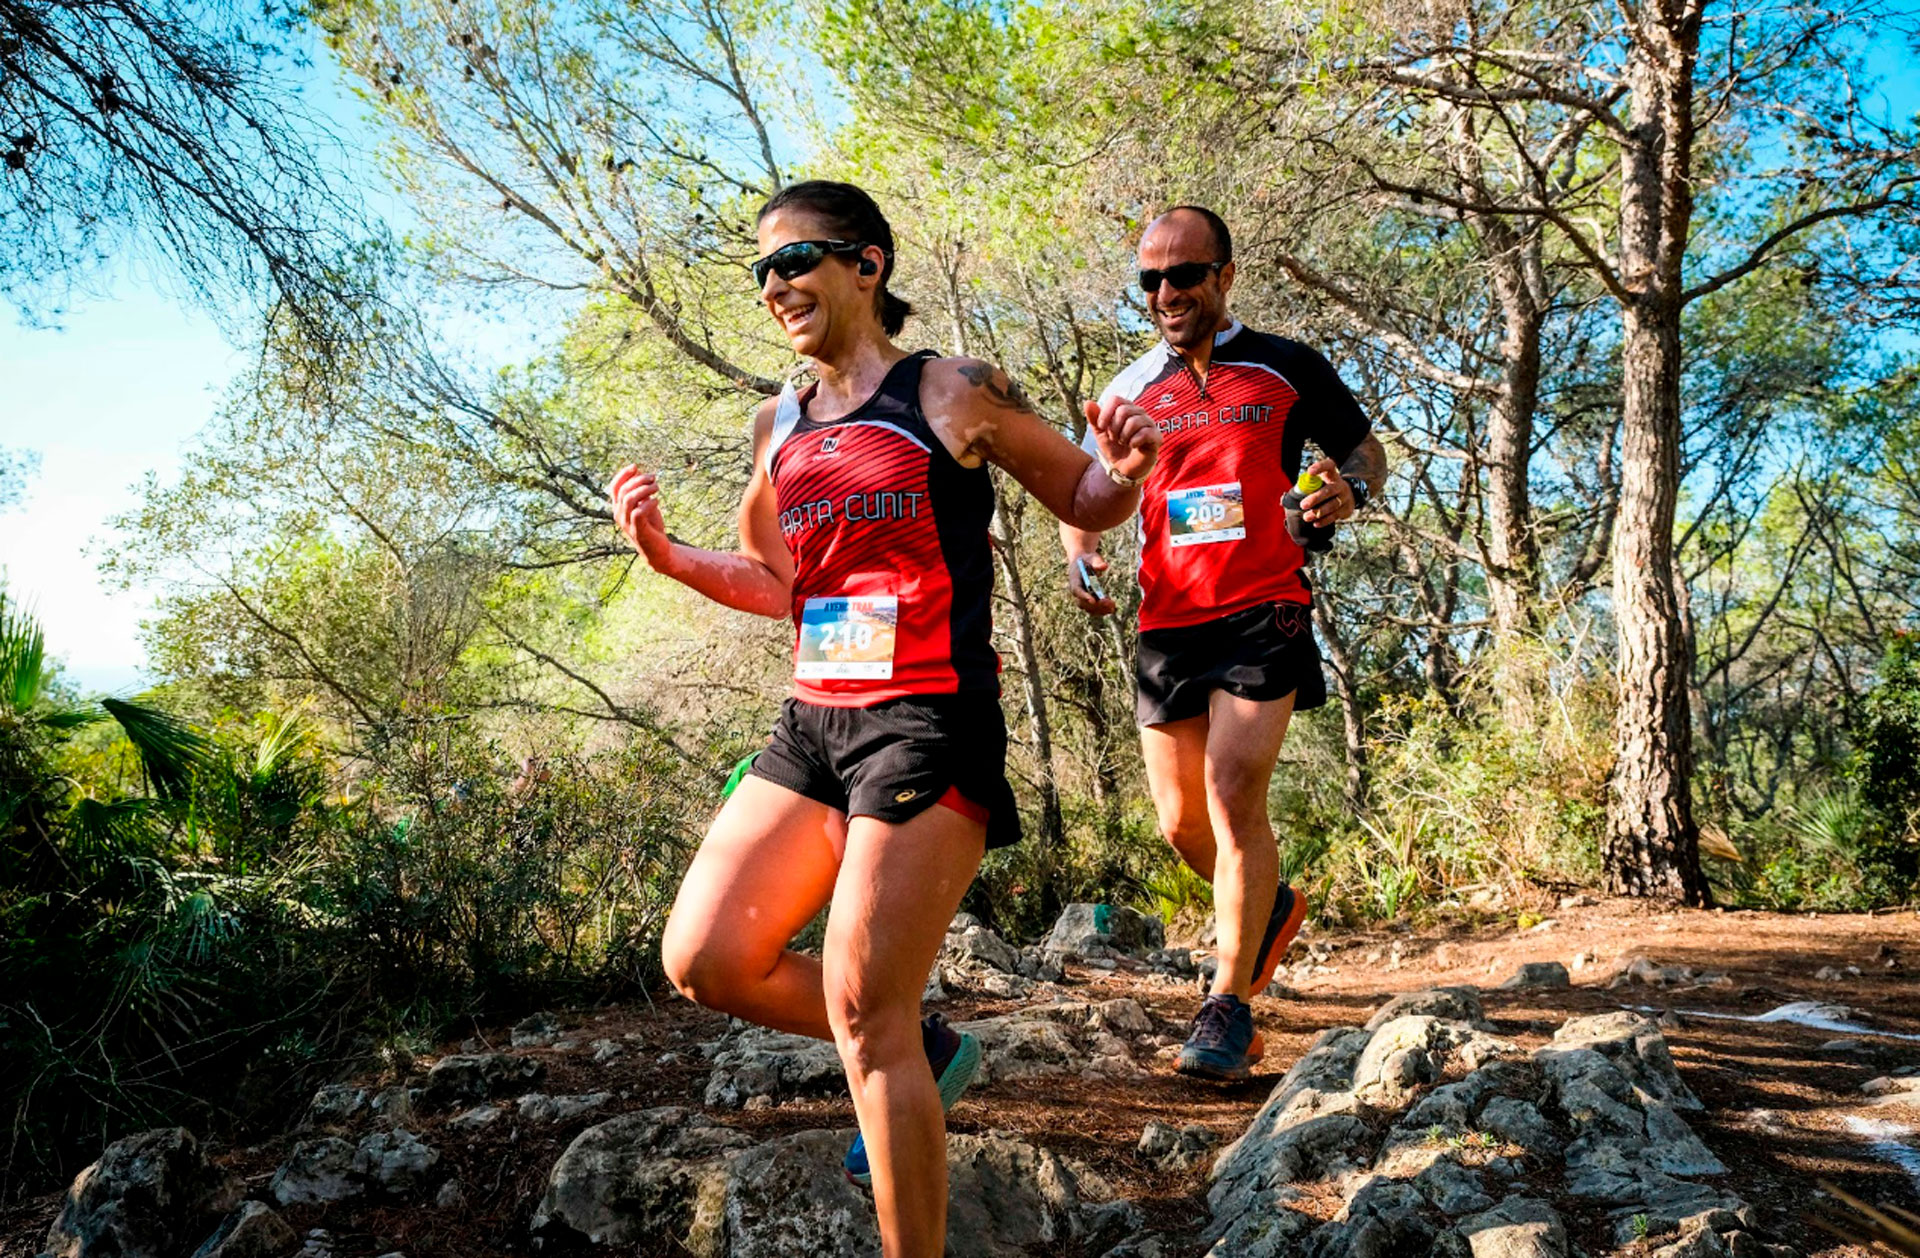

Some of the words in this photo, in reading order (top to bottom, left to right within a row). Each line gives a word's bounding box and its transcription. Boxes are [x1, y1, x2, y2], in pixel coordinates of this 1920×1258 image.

[1219, 404, 1275, 424] CUNIT
[844, 492, 924, 522] CUNIT
[1185, 503, 1226, 526] 209
